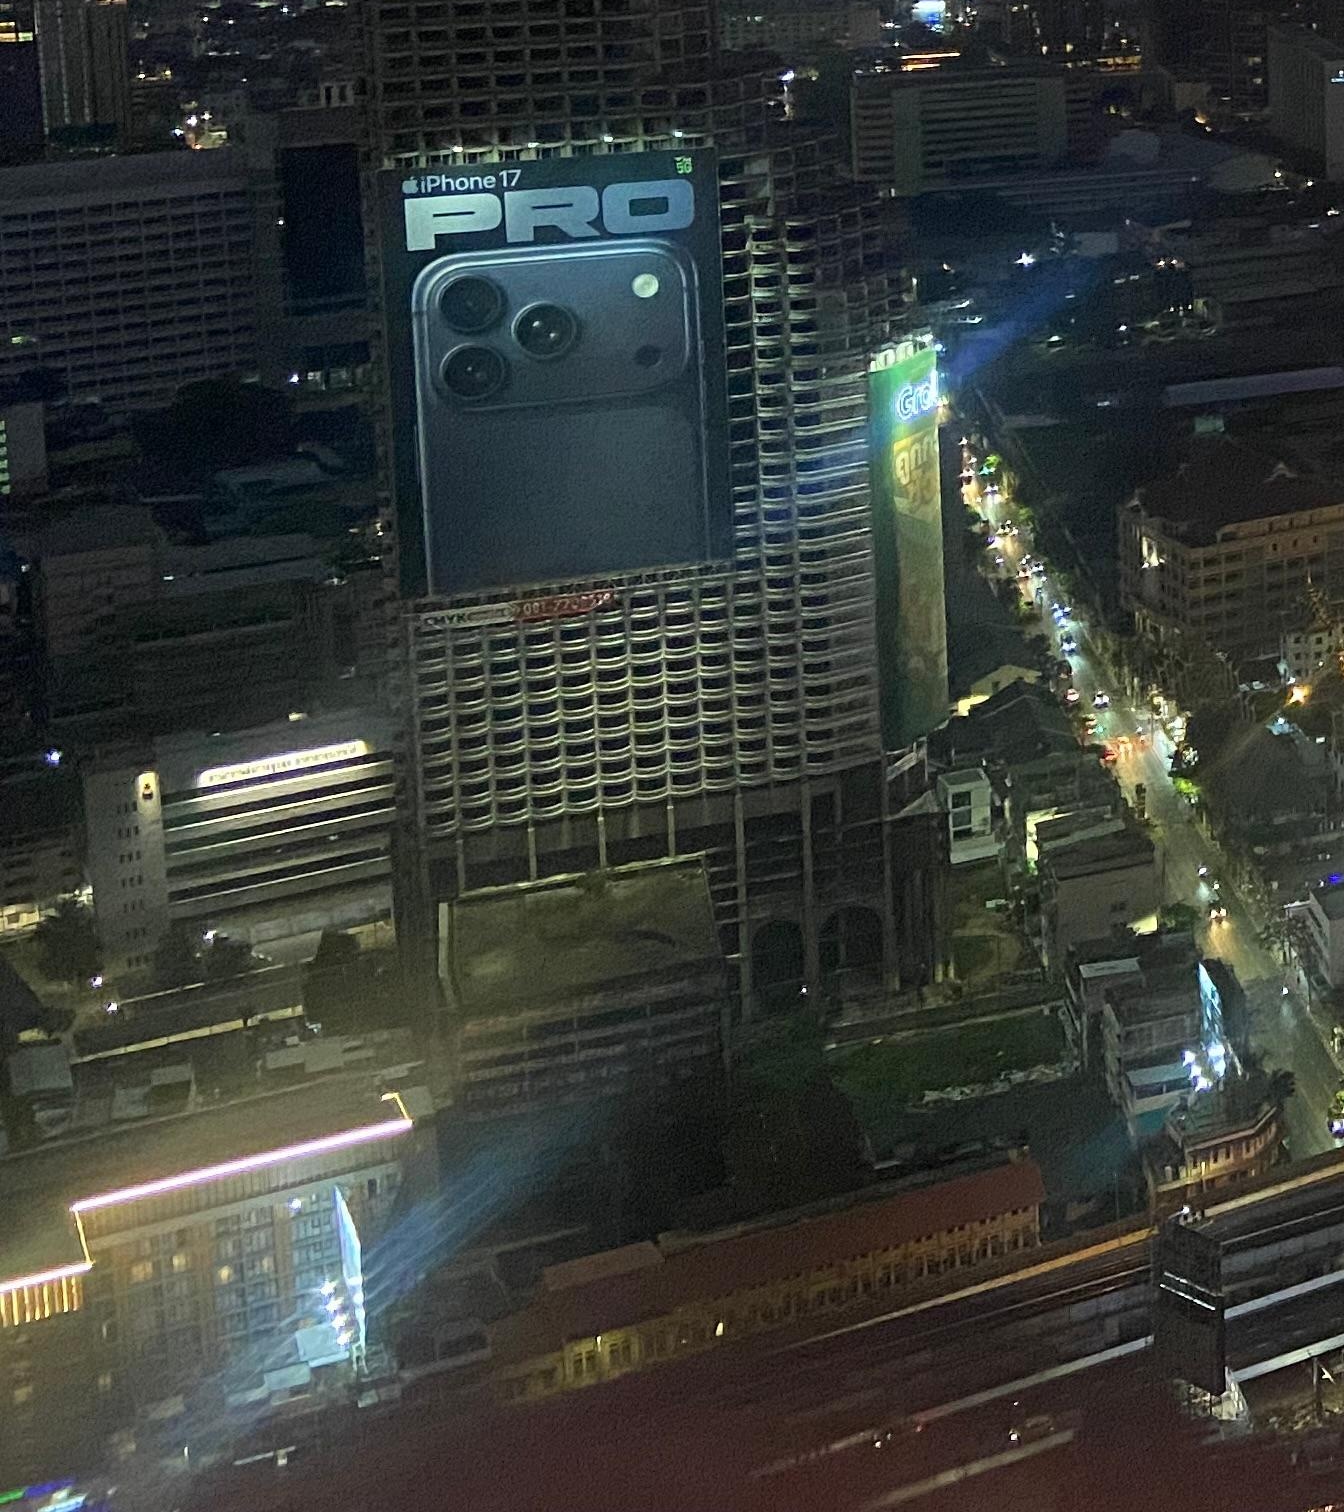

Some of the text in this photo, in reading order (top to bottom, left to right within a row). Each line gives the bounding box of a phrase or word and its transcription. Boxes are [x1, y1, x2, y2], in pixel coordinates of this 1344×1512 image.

[420, 169, 522, 193] iPhone 17
[404, 178, 696, 252] PRO
